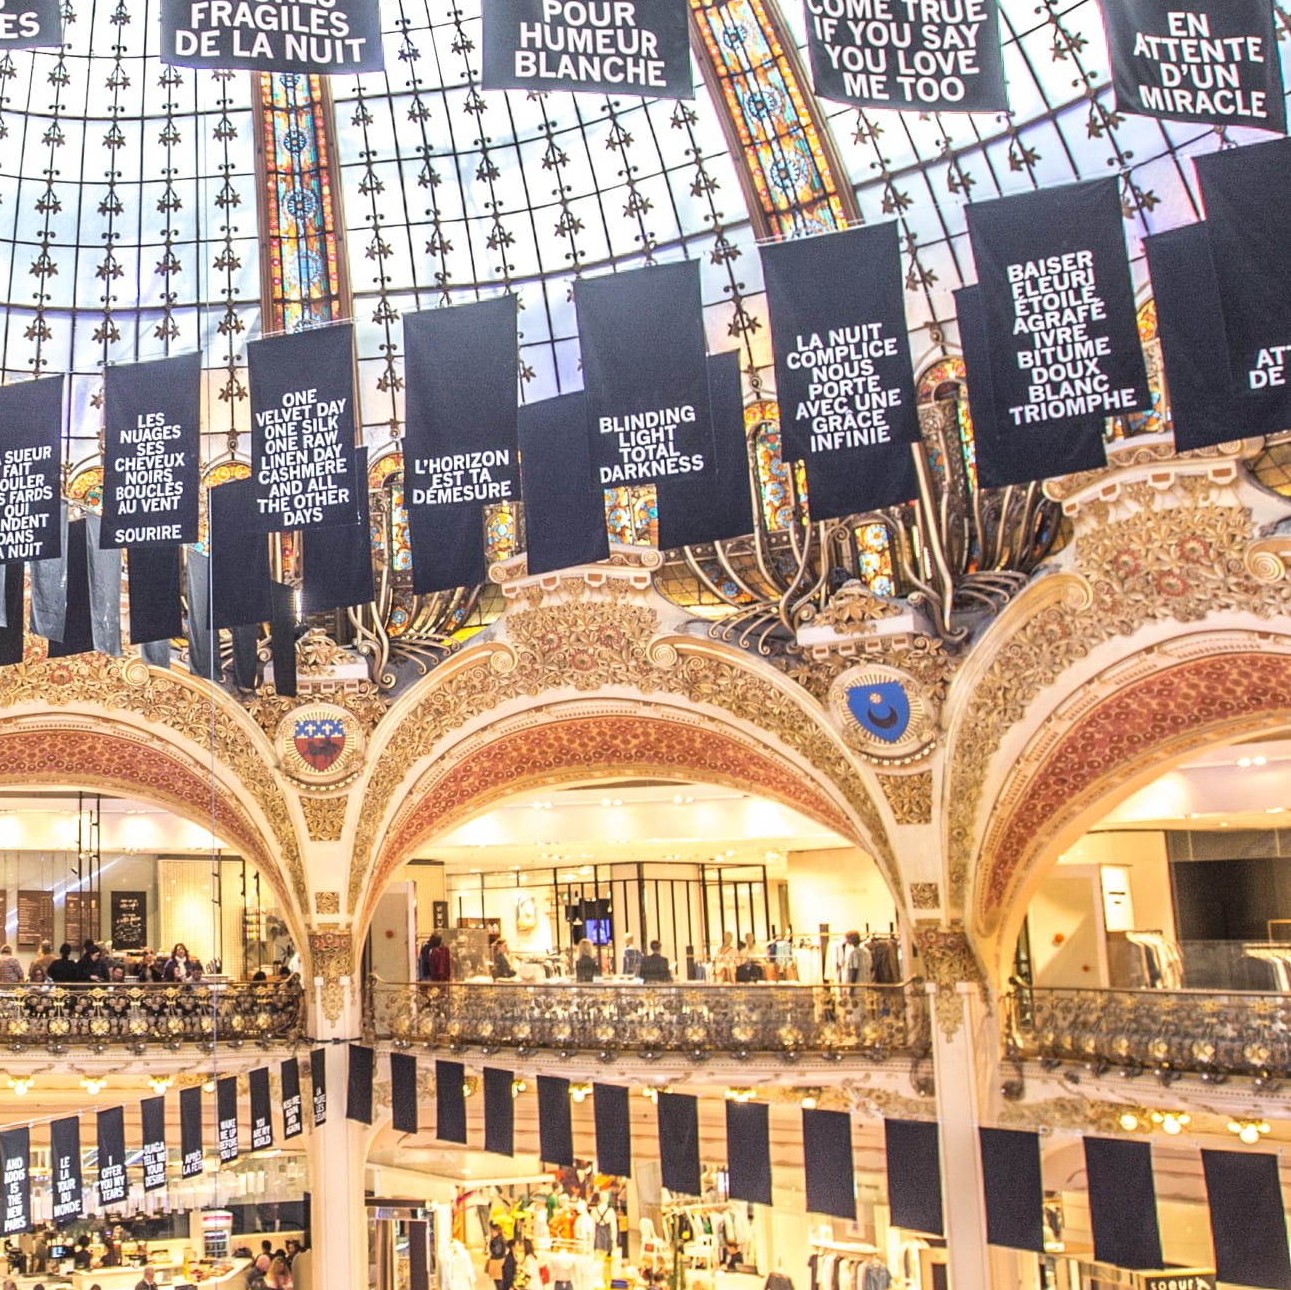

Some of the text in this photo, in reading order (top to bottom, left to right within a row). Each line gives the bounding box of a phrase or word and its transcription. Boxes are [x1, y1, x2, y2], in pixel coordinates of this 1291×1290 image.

[191, 0, 349, 37] FRAGILES
[1168, 12, 1209, 37] EN
[176, 30, 366, 63] DE LA NUIT
[520, 22, 658, 58] HUMEUR
[1134, 32, 1264, 63] ATTENTE
[515, 51, 666, 87] BLANCHE
[1160, 63, 1239, 89] D'UN
[1139, 85, 1266, 118] MIRACLE
[1007, 250, 1093, 283] BAISER
[1012, 267, 1094, 299] FLEURI
[1013, 300, 1108, 335] AGRAFÉ
[1034, 323, 1088, 349] IVRE
[1017, 336, 1111, 369] BITUME
[1032, 357, 1100, 384] DOUX
[1029, 374, 1109, 403] BLANC
[599, 405, 695, 433] BLINDING
[1009, 385, 1137, 427] TRIOMPHE
[138, 412, 165, 428] LES
[120, 425, 181, 444] NUAGES
[619, 424, 677, 447] LIGHT
[136, 441, 165, 456] SES
[619, 441, 680, 463] TOTAL
[115, 452, 185, 472] CHEVEUX
[415, 450, 509, 474] L'HORIZON
[600, 454, 704, 483] DARKNESS
[125, 466, 174, 485] NOIRS
[431, 468, 492, 487] EST TA
[118, 496, 181, 515] AU VENT
[413, 480, 511, 506] DÉMESURE
[115, 524, 182, 543] SOURIRE
